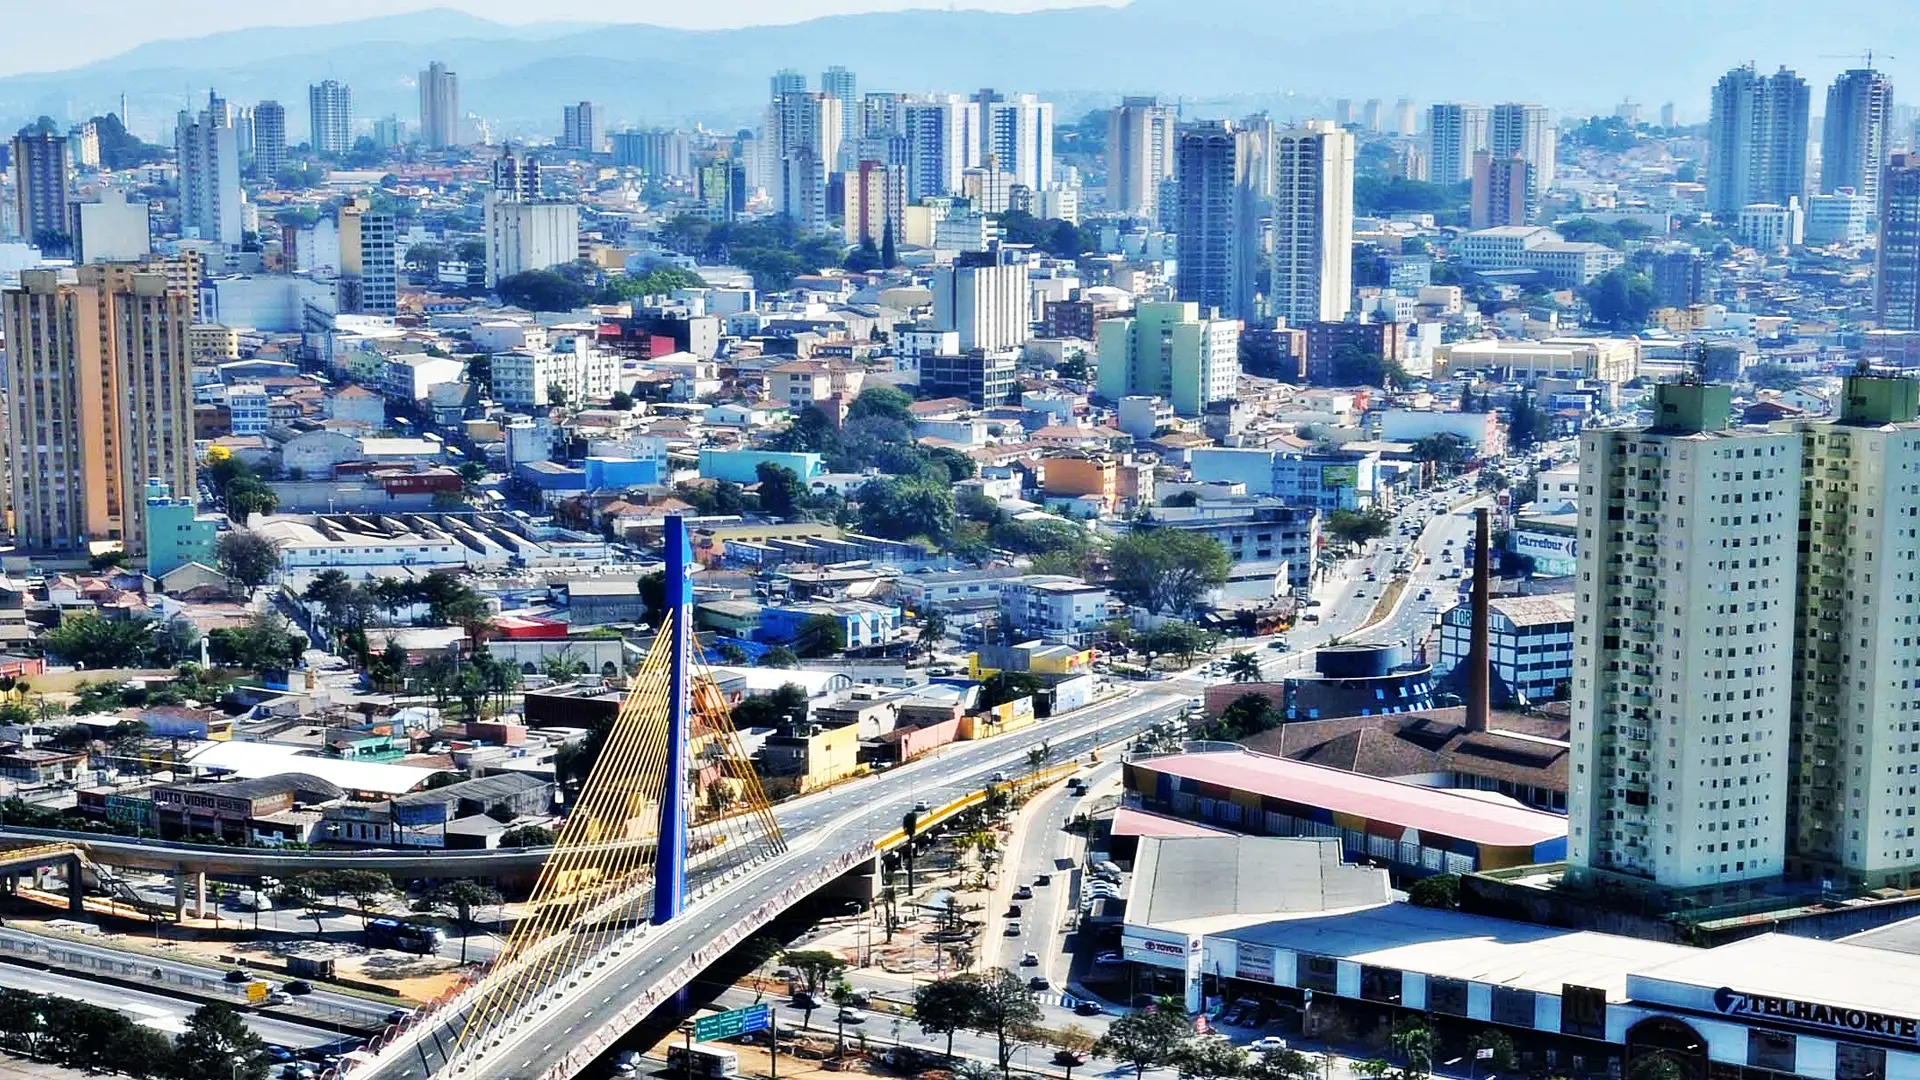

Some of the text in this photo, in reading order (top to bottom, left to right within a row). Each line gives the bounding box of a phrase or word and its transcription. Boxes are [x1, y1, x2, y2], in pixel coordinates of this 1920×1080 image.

[1518, 535, 1563, 550] Carrefour
[154, 790, 182, 804] AUTO
[184, 793, 214, 808] VIDRO
[1155, 943, 1183, 954] TOYOTA
[1747, 995, 1917, 1034] TELHANORTE
